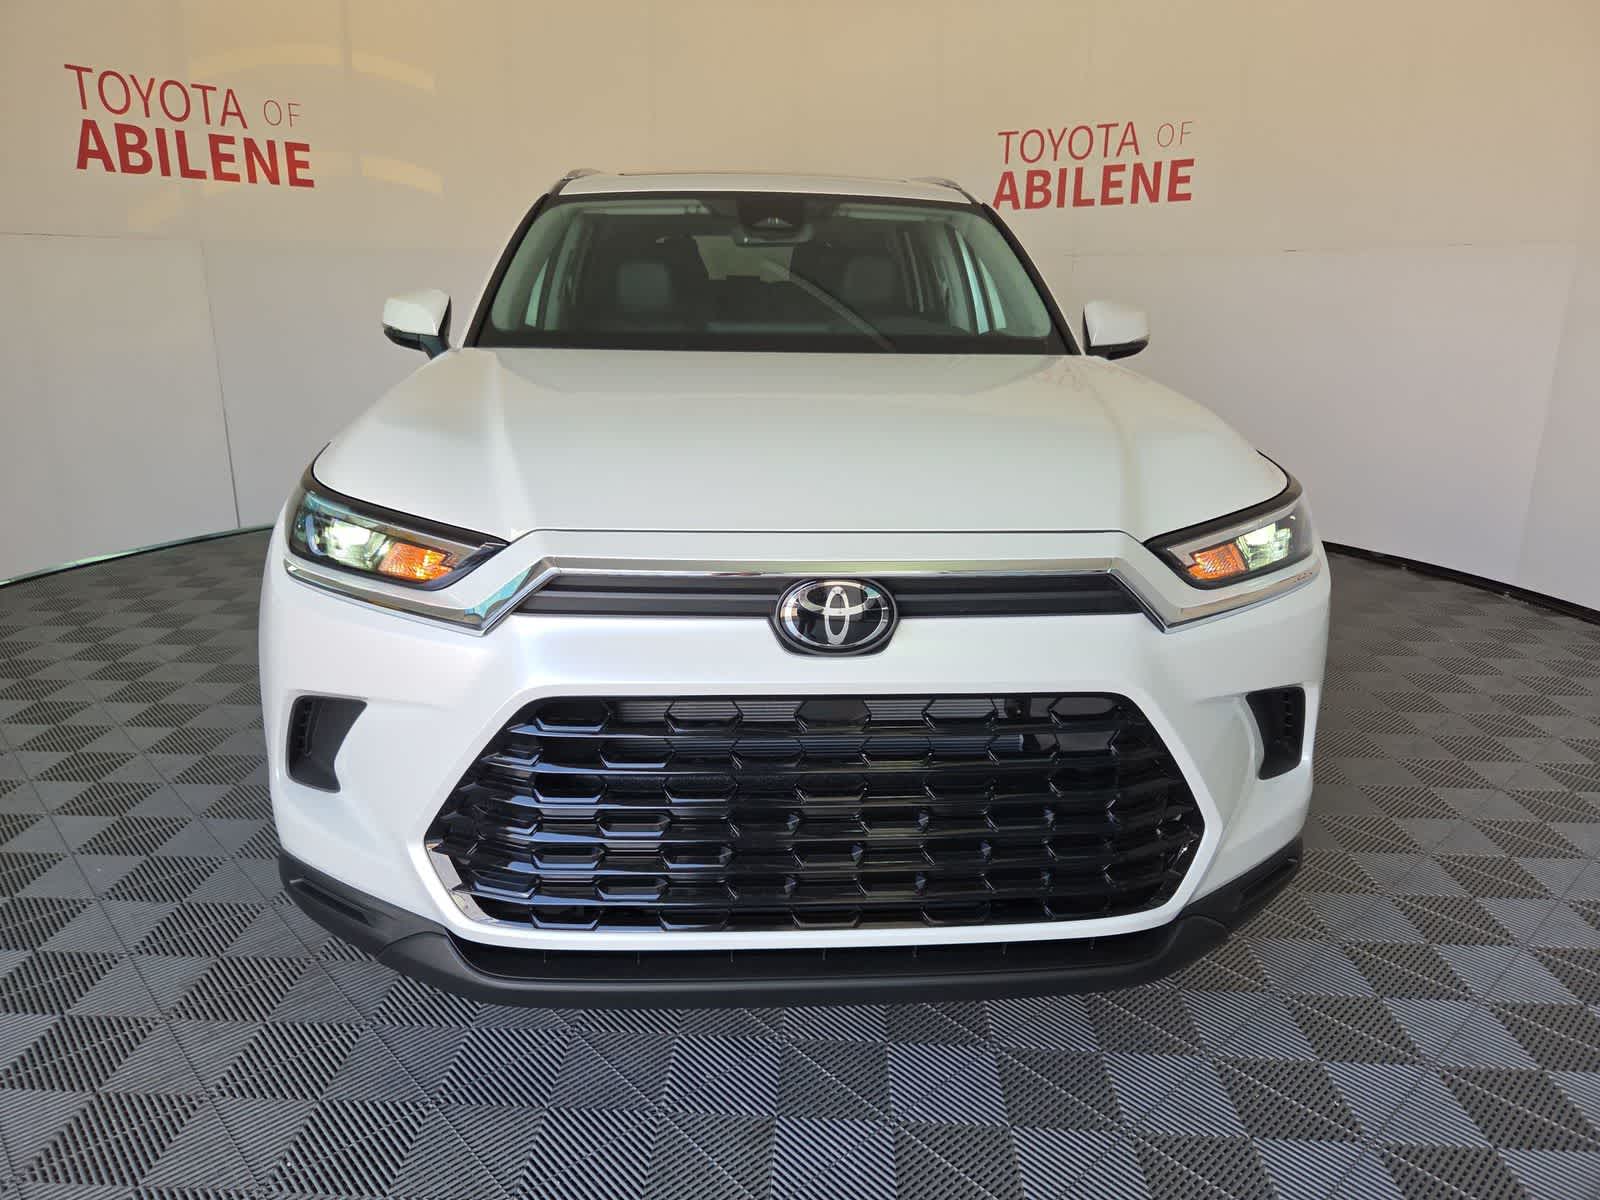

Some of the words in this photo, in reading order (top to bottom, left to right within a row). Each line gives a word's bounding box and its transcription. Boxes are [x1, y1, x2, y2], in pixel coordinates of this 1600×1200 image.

[64, 63, 248, 129] TOYOTA
[263, 99, 301, 128] OF
[76, 118, 315, 188] ABILENE
[998, 121, 1140, 165] TOYOTA
[1157, 120, 1193, 148] OF
[992, 158, 1195, 210] ABILENE
